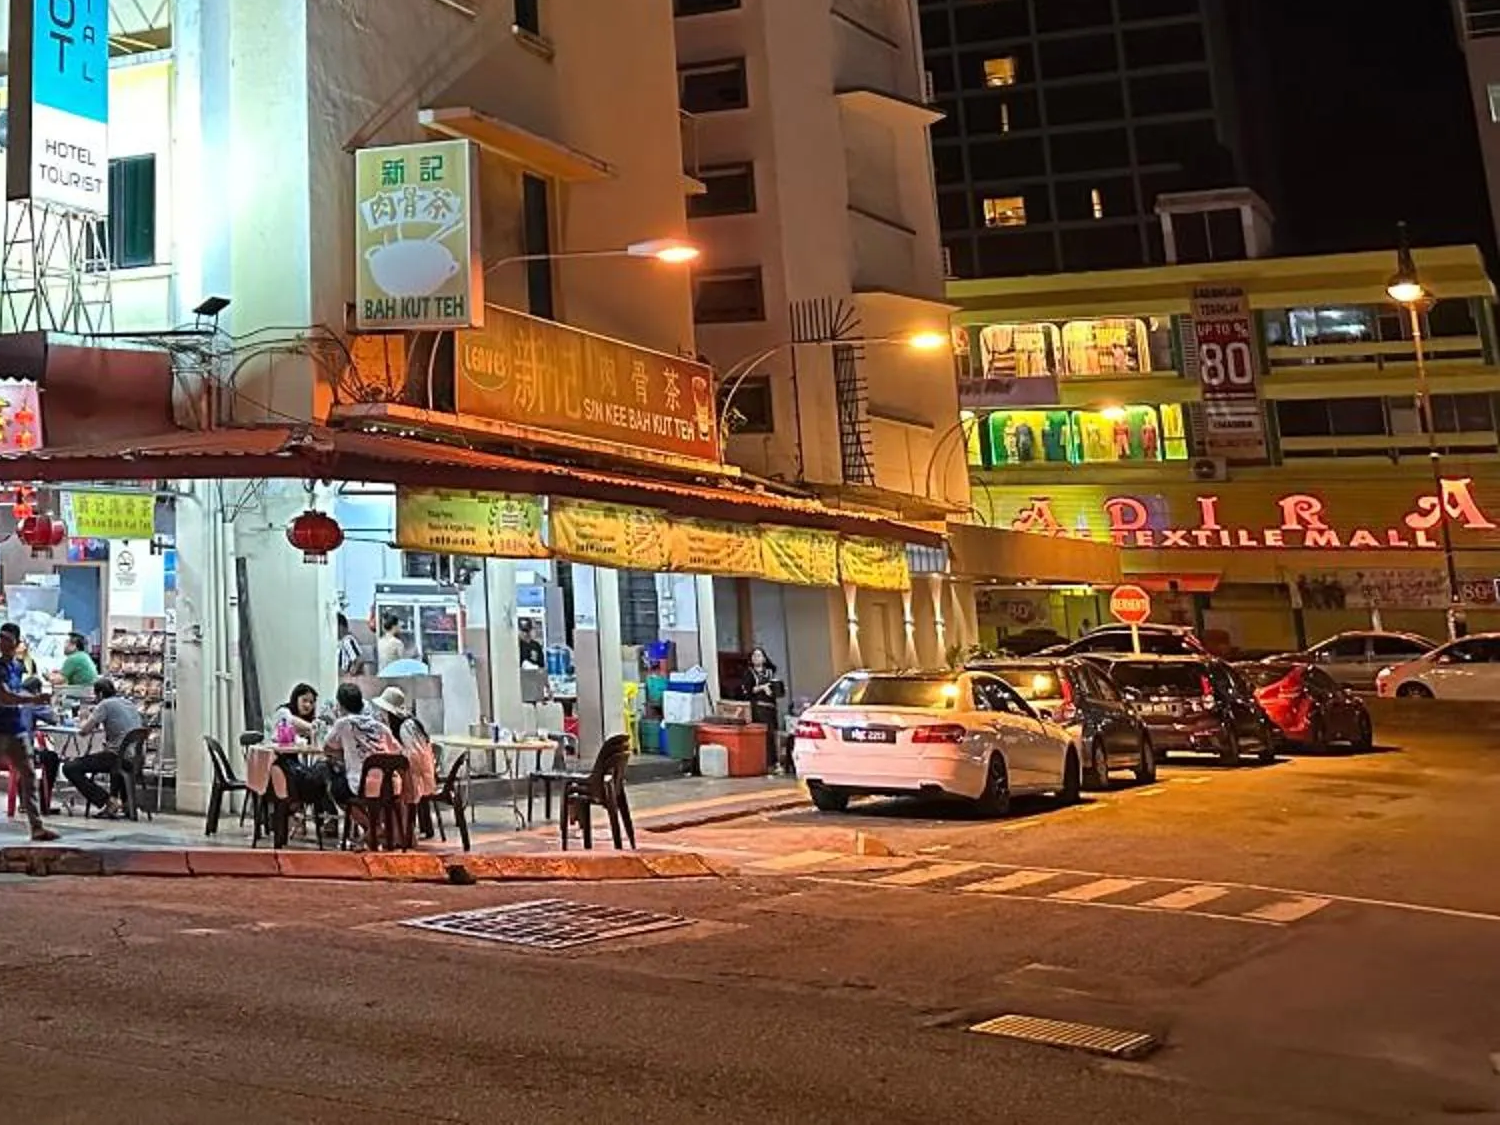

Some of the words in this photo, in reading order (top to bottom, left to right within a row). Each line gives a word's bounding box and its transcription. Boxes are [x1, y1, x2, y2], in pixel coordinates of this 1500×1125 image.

[45, 138, 96, 167] HOTEL
[38, 163, 102, 194] TOURIST
[381, 154, 443, 186] 新記
[369, 186, 454, 225] 肉骨茶
[364, 298, 396, 320] BAH
[401, 297, 431, 319] KUT
[435, 296, 465, 318] TEH
[1200, 342, 1254, 386] 80
[583, 397, 603, 423] SIN
[605, 402, 627, 428] KEE
[628, 408, 651, 433] BAH
[652, 412, 674, 437] KUT
[675, 417, 695, 442] TEH
[1011, 478, 1498, 532] ADIRA
[1111, 530, 1284, 548] TEXTILE
[1305, 530, 1437, 549] MALL
